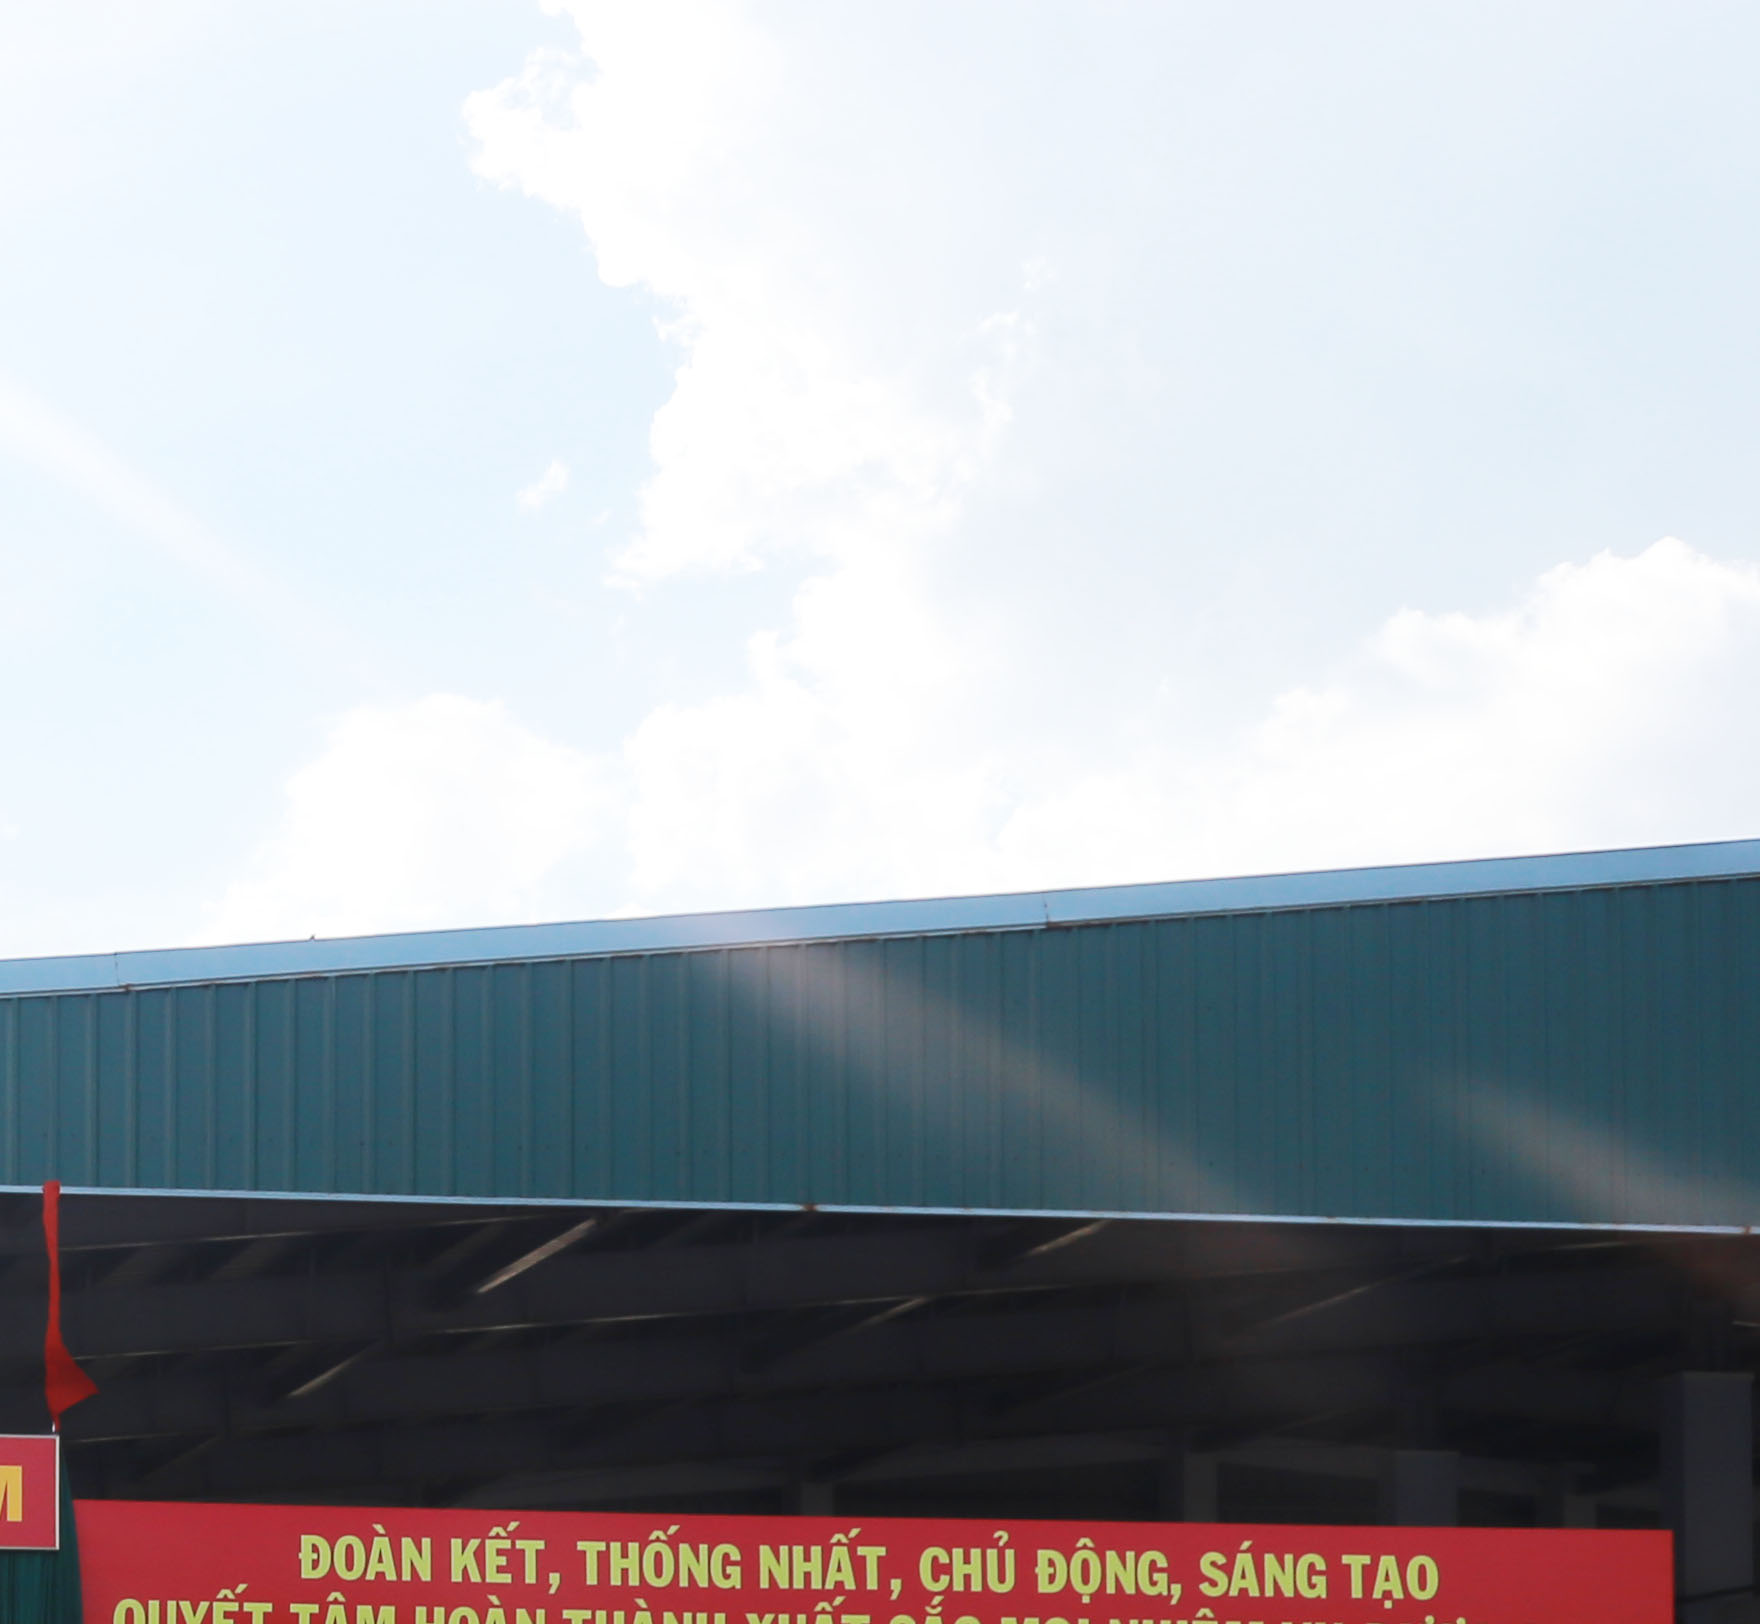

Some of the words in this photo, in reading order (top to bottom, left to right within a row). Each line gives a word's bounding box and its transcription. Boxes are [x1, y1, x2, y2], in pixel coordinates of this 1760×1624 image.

[299, 1525, 432, 1582] ĐOÀN
[451, 1521, 561, 1594] KẾT,
[577, 1525, 742, 1589] THỐNG
[759, 1528, 902, 1599] NHẤT,
[919, 1530, 1016, 1593] CHỦ
[1035, 1537, 1182, 1604] ĐỘNG,
[1200, 1540, 1327, 1599] SÁNG
[1341, 1554, 1439, 1609] TẠO
